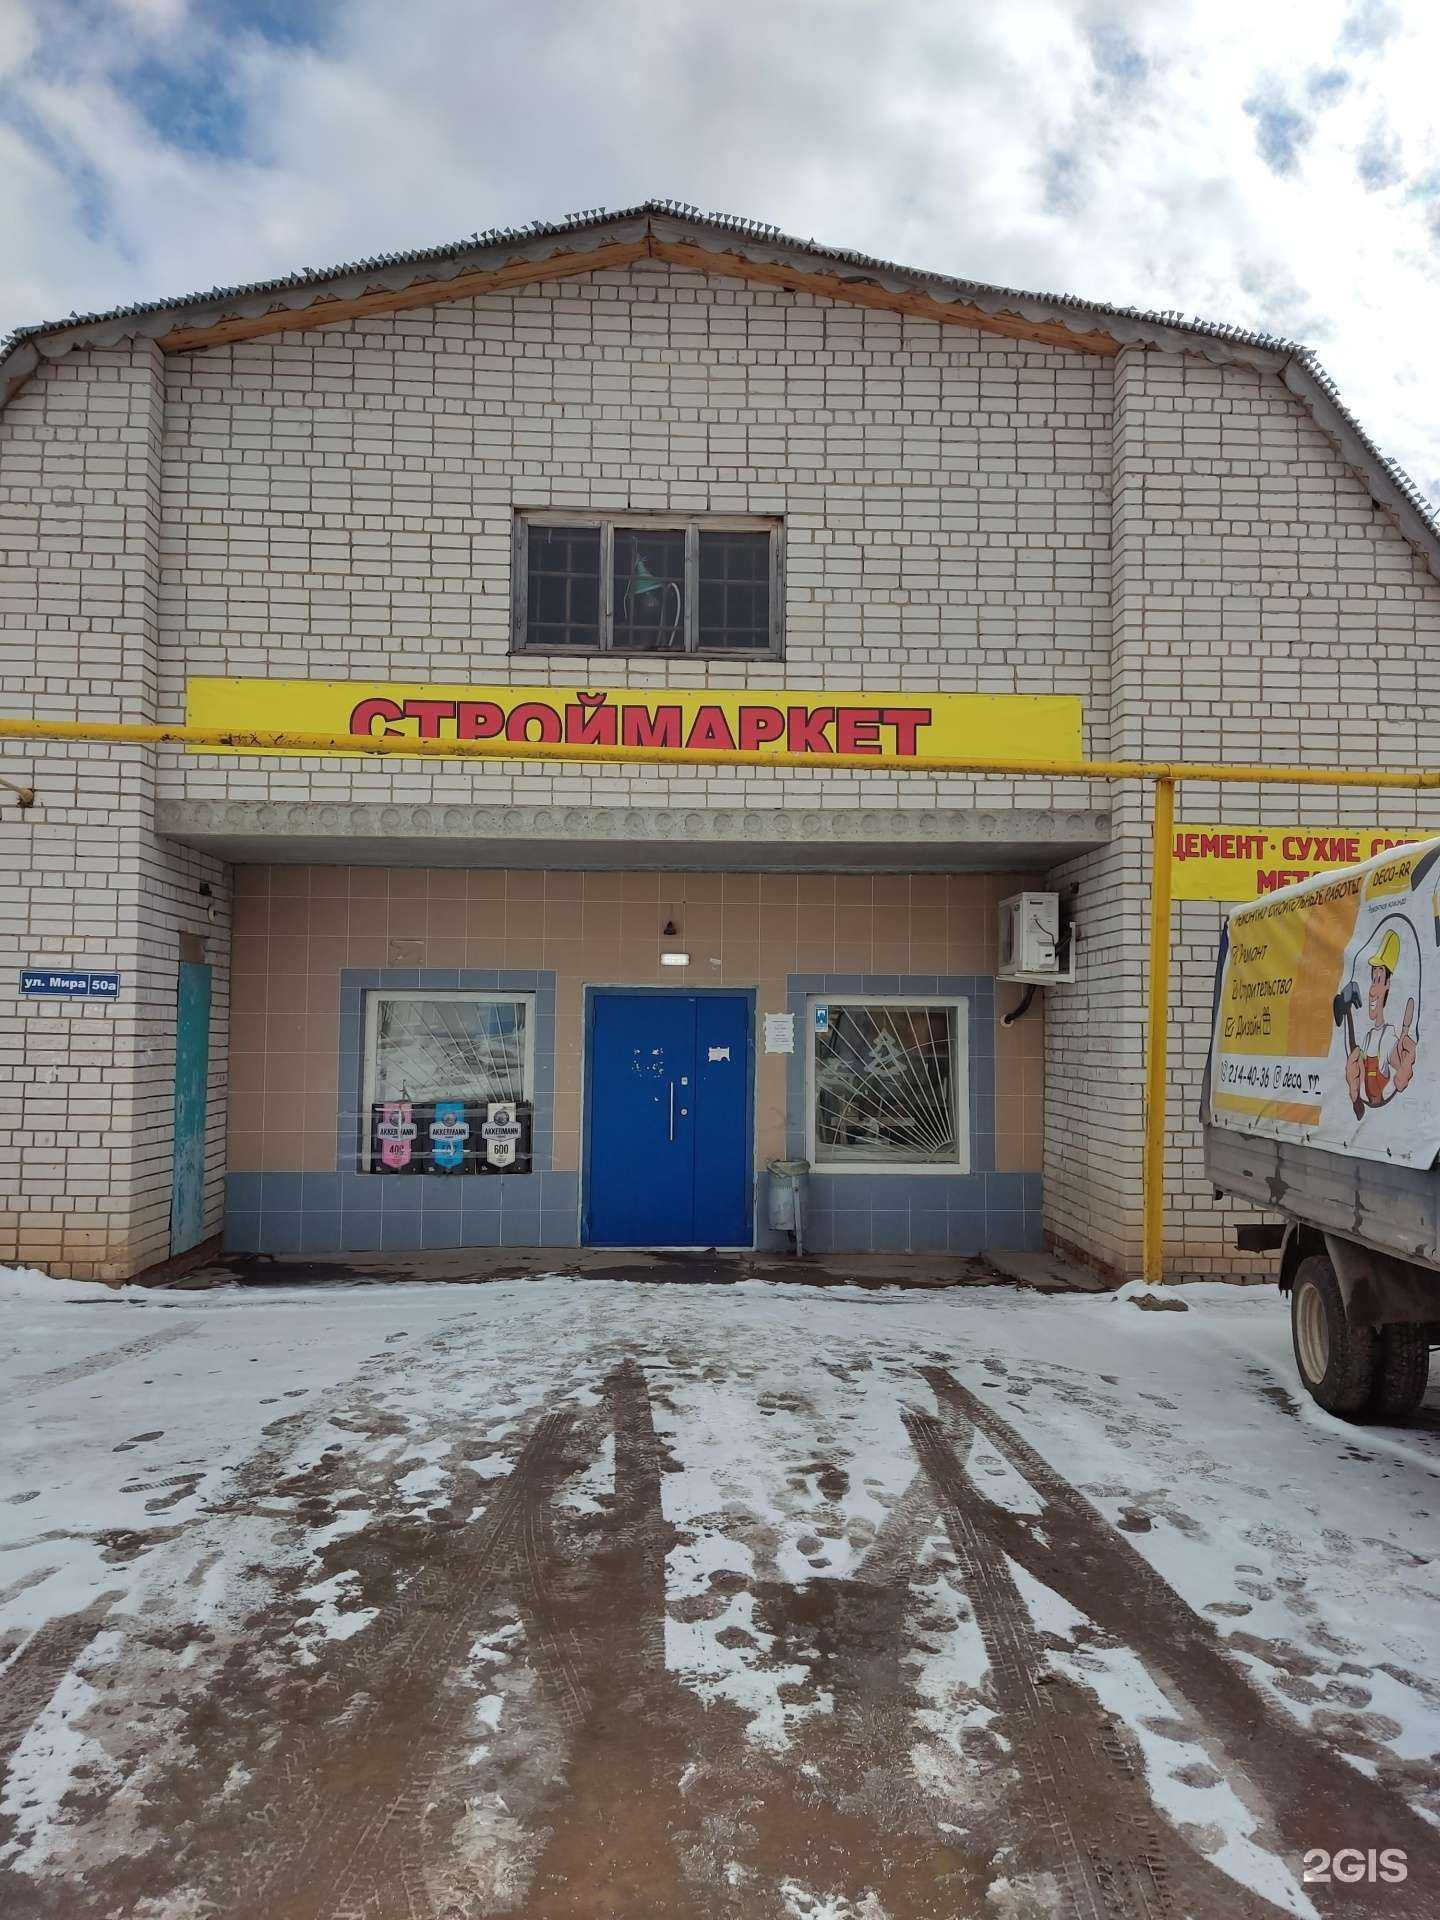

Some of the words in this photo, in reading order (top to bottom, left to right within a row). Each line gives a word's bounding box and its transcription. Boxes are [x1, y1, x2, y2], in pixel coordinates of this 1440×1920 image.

[350, 692, 932, 756] СТРОЙМАРКЕТ
[1282, 836, 1361, 862] СУХИЕ
[1257, 870, 1321, 894] МЕТ
[1373, 861, 1411, 886] DECO-RR
[24, 978, 45, 988] ул.
[49, 977, 86, 990] Мира
[92, 980, 116, 991] 50а
[1228, 1064, 1270, 1089] 214-40-36
[484, 1127, 519, 1136] AKKERMANN
[494, 1144, 509, 1155] 600
